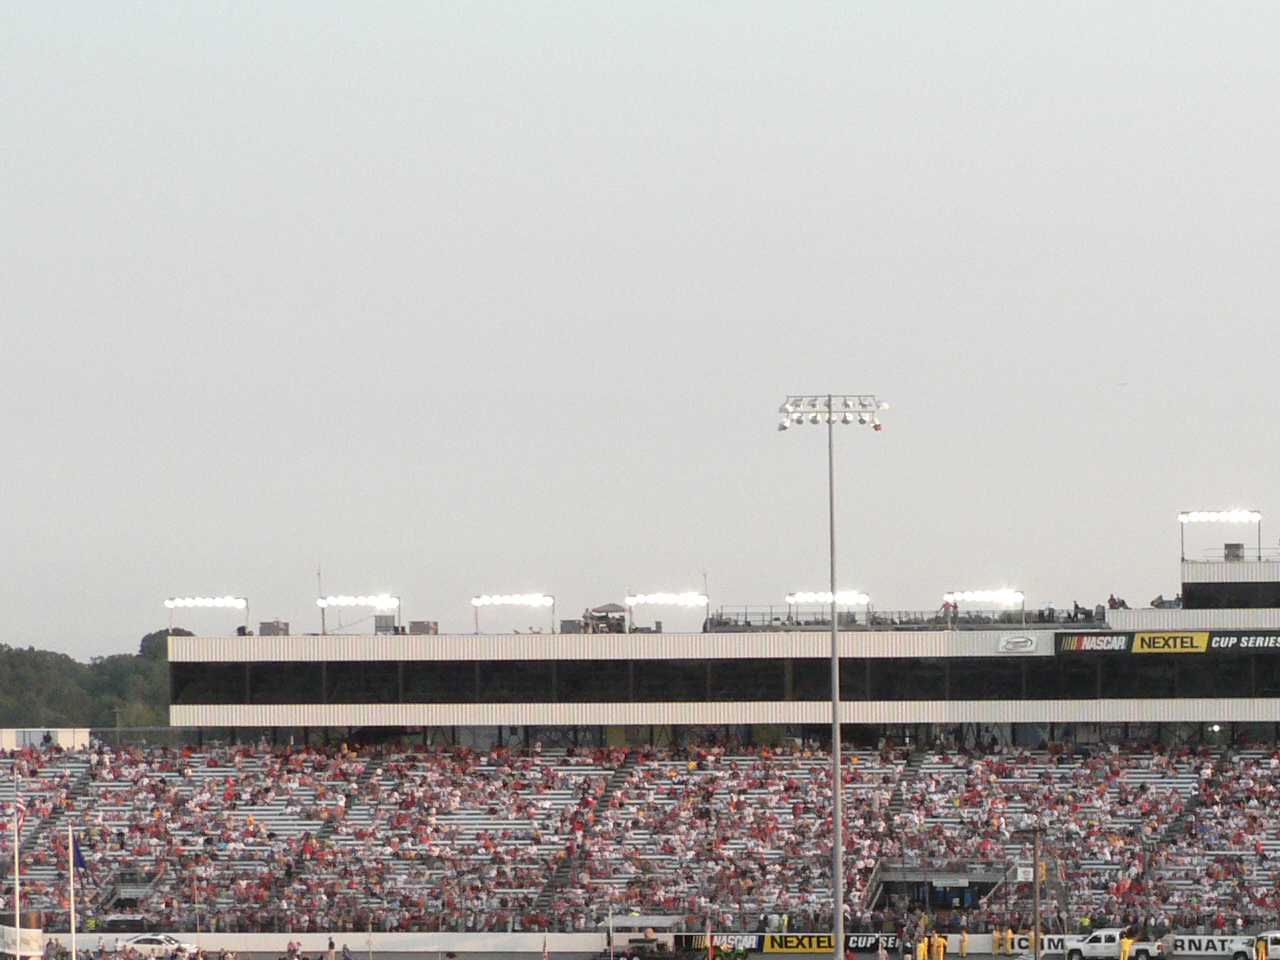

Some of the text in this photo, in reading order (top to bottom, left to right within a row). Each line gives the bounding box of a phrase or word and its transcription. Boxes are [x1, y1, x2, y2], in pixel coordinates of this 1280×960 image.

[1081, 635, 1127, 651] NASCAR
[1140, 636, 1199, 650] NEXTEL
[1211, 636, 1238, 648] CUP
[712, 935, 758, 949] NASCAR
[770, 935, 836, 949] NEXTEL
[848, 936, 878, 948] CUP
